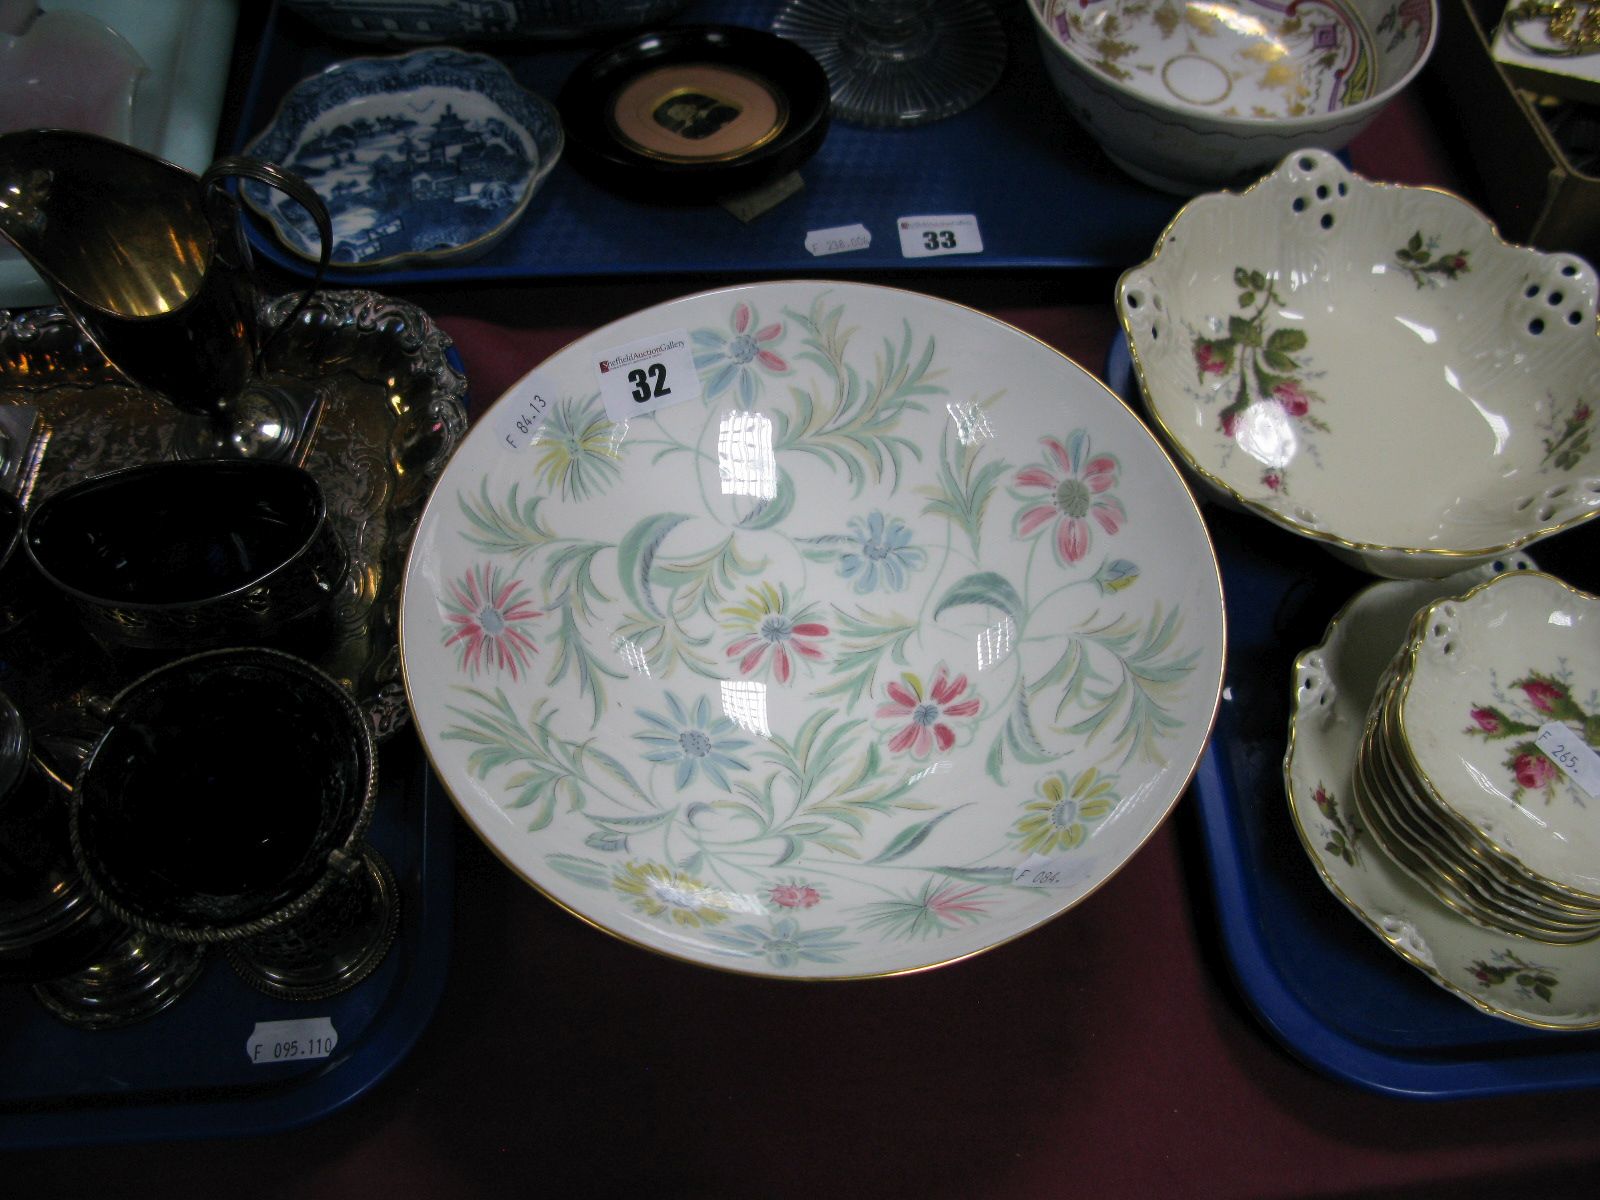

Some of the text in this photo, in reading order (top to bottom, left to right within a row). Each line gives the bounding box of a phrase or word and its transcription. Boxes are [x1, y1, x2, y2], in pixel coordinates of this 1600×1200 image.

[922, 230, 957, 251] 33
[627, 363, 672, 403] 32
[505, 394, 547, 449] F 84.13
[1537, 730, 1552, 741] F
[1015, 869, 1031, 881] F
[253, 1038, 332, 1060] F 095.110
